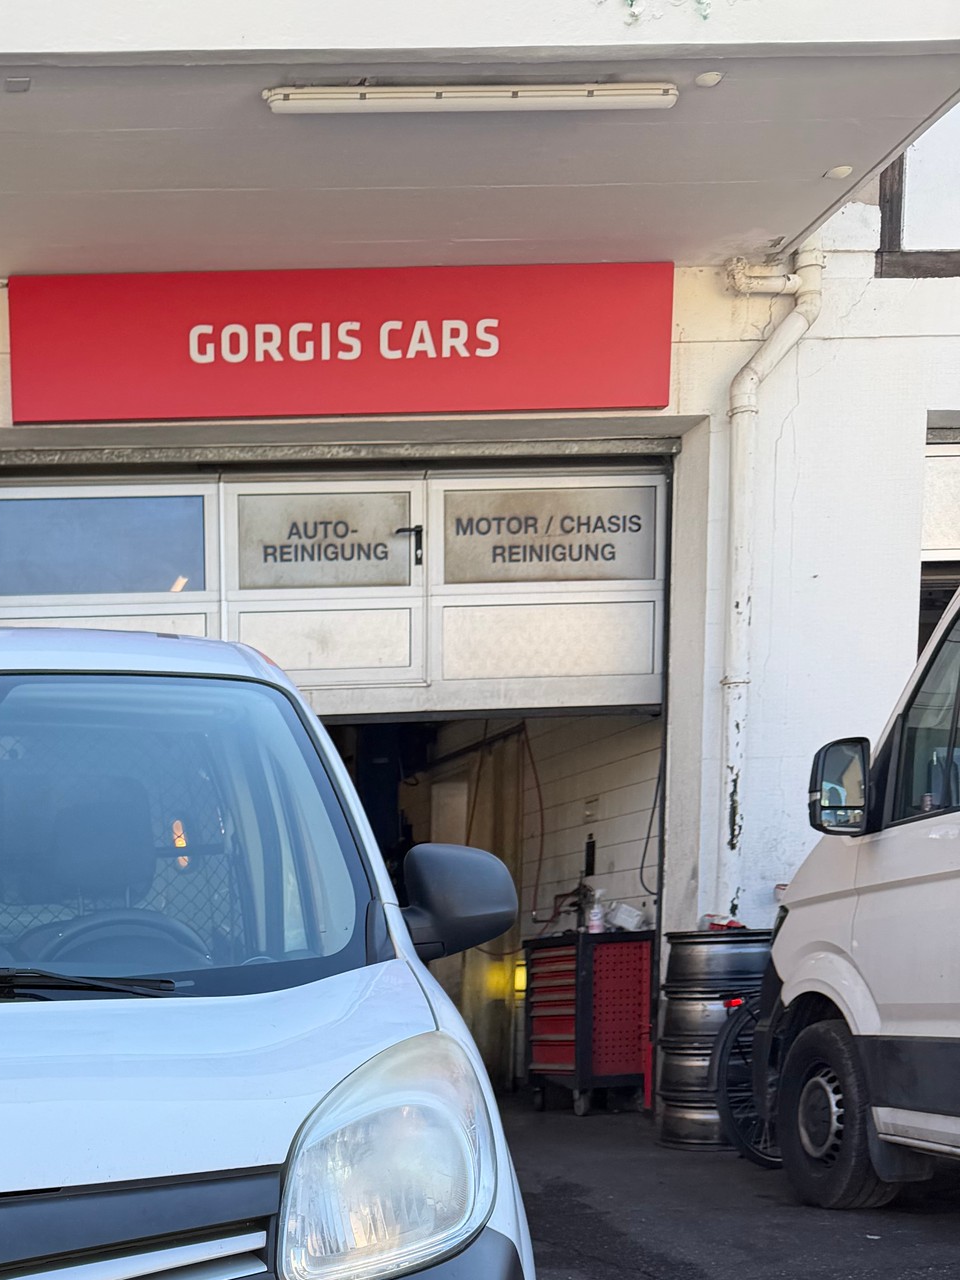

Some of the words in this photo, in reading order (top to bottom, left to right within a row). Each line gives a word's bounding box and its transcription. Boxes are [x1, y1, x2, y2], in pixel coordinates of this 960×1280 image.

[188, 320, 362, 364] GORGIS
[378, 318, 500, 360] CARS
[286, 520, 359, 541] AUTO-
[454, 515, 538, 537] MOTOR
[559, 514, 643, 535] CHASIS
[262, 541, 389, 564] REINIGUNG
[491, 542, 616, 564] REINIGUNG
